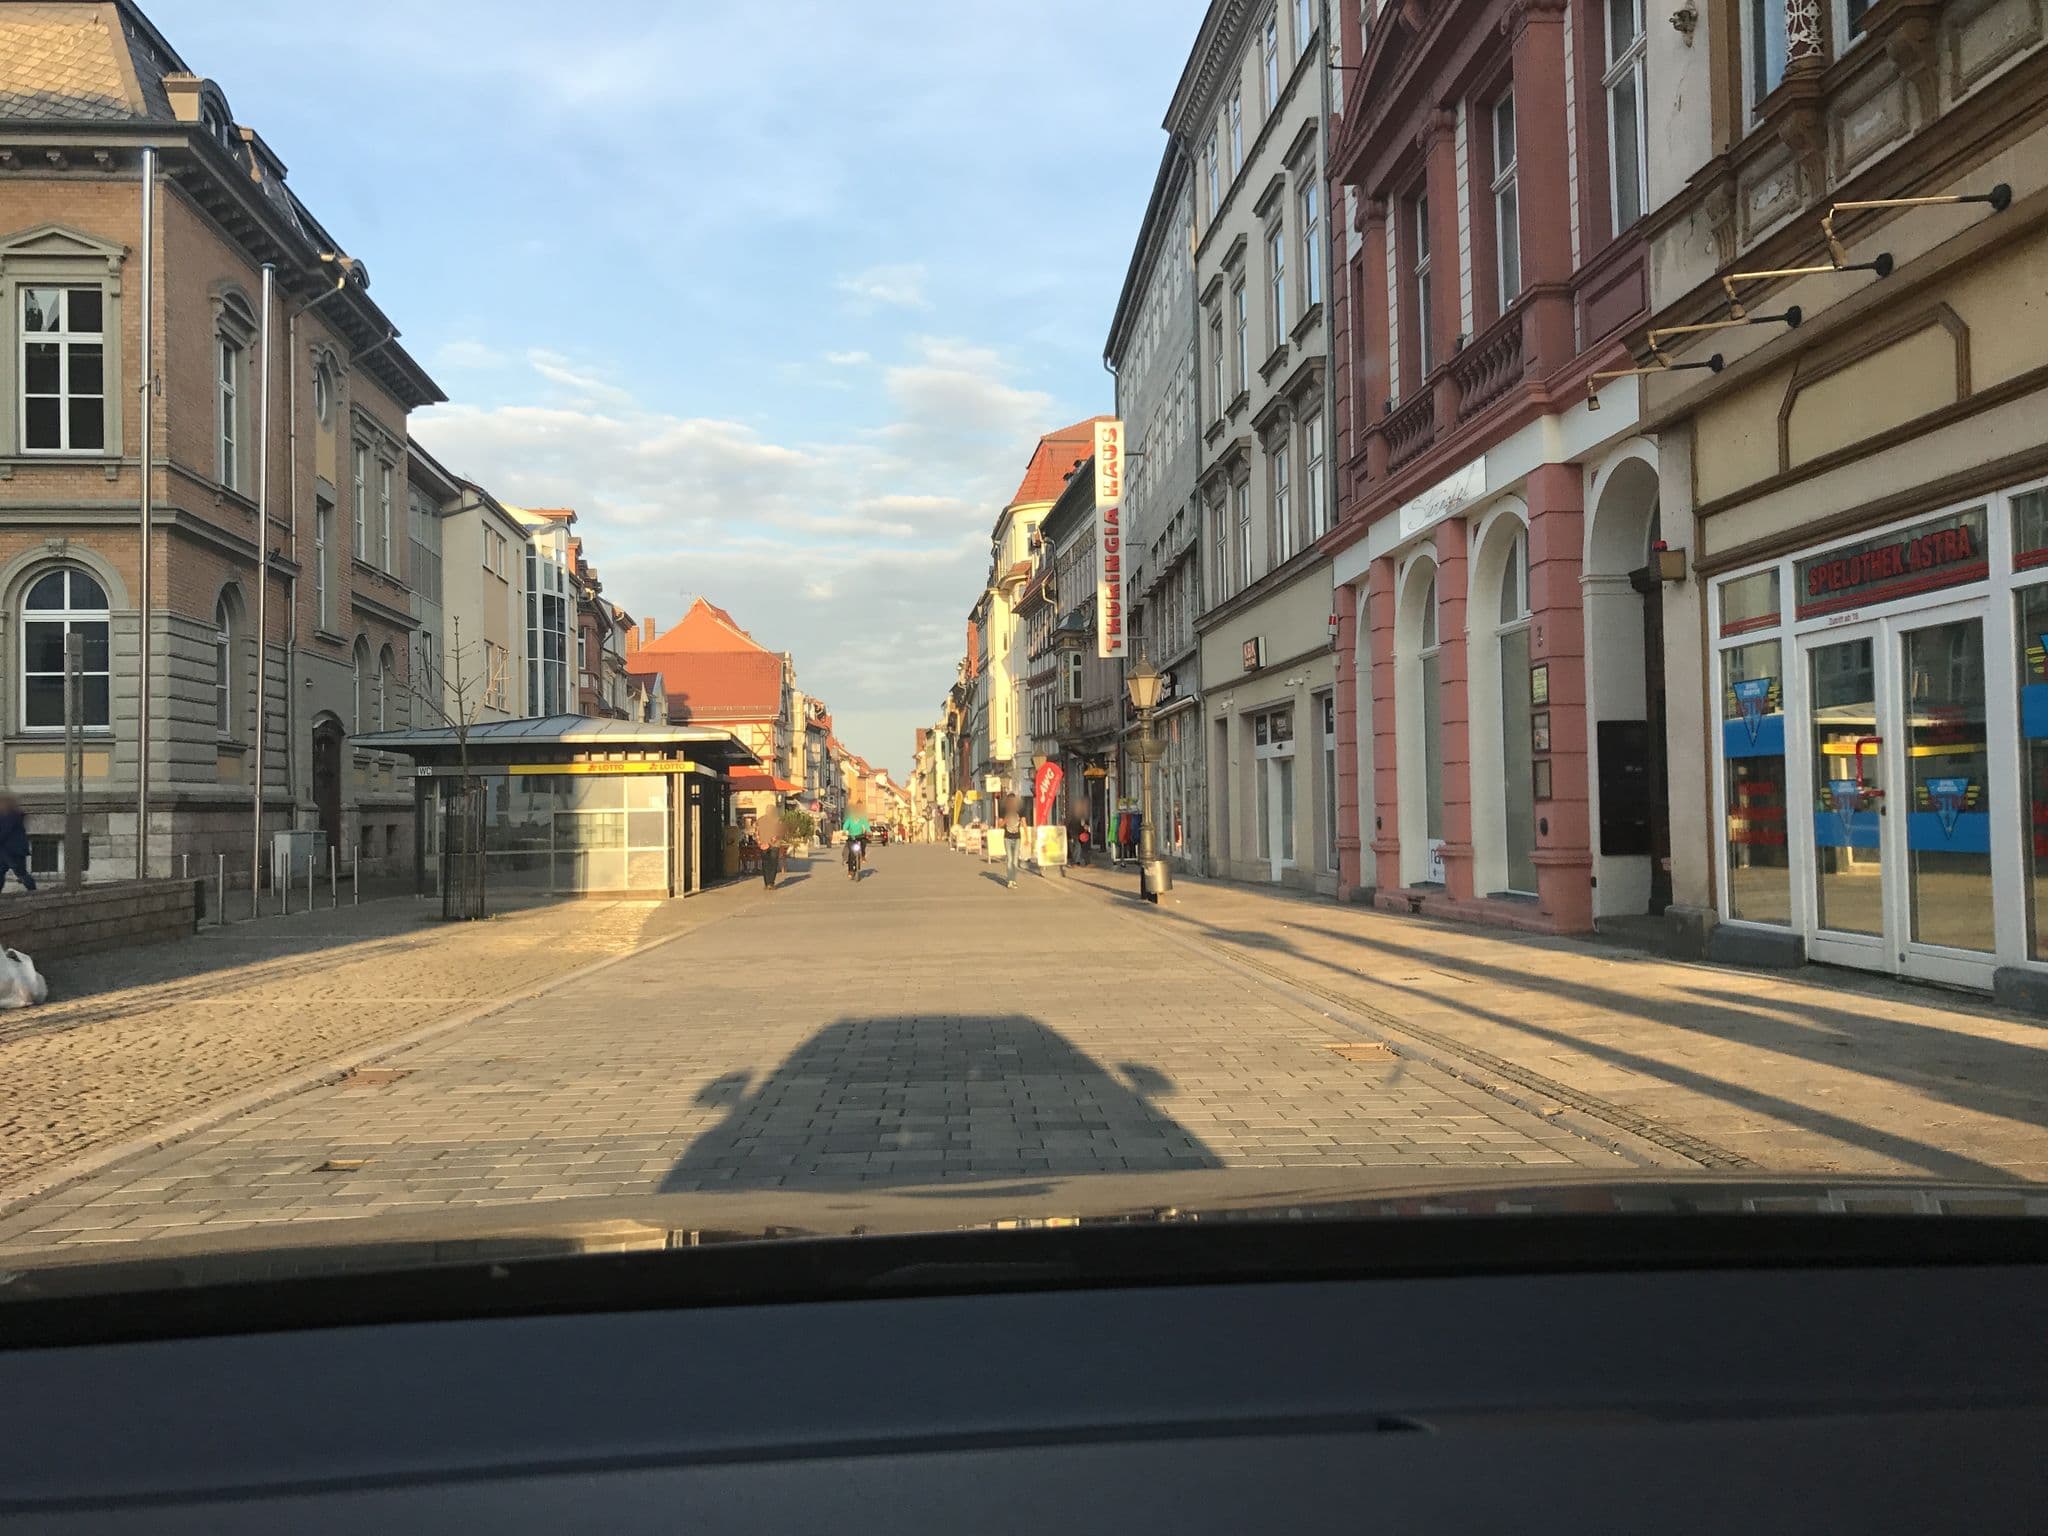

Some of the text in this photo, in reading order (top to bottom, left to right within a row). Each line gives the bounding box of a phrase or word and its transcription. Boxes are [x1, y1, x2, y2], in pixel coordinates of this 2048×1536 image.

[1102, 427, 1121, 653] THURINGIA HAUS
[1808, 524, 1971, 596] SPIELOTHEK ASTRA
[599, 764, 625, 772] LOTTO
[659, 763, 686, 771] LOTTO
[1039, 767, 1055, 804] AWG
